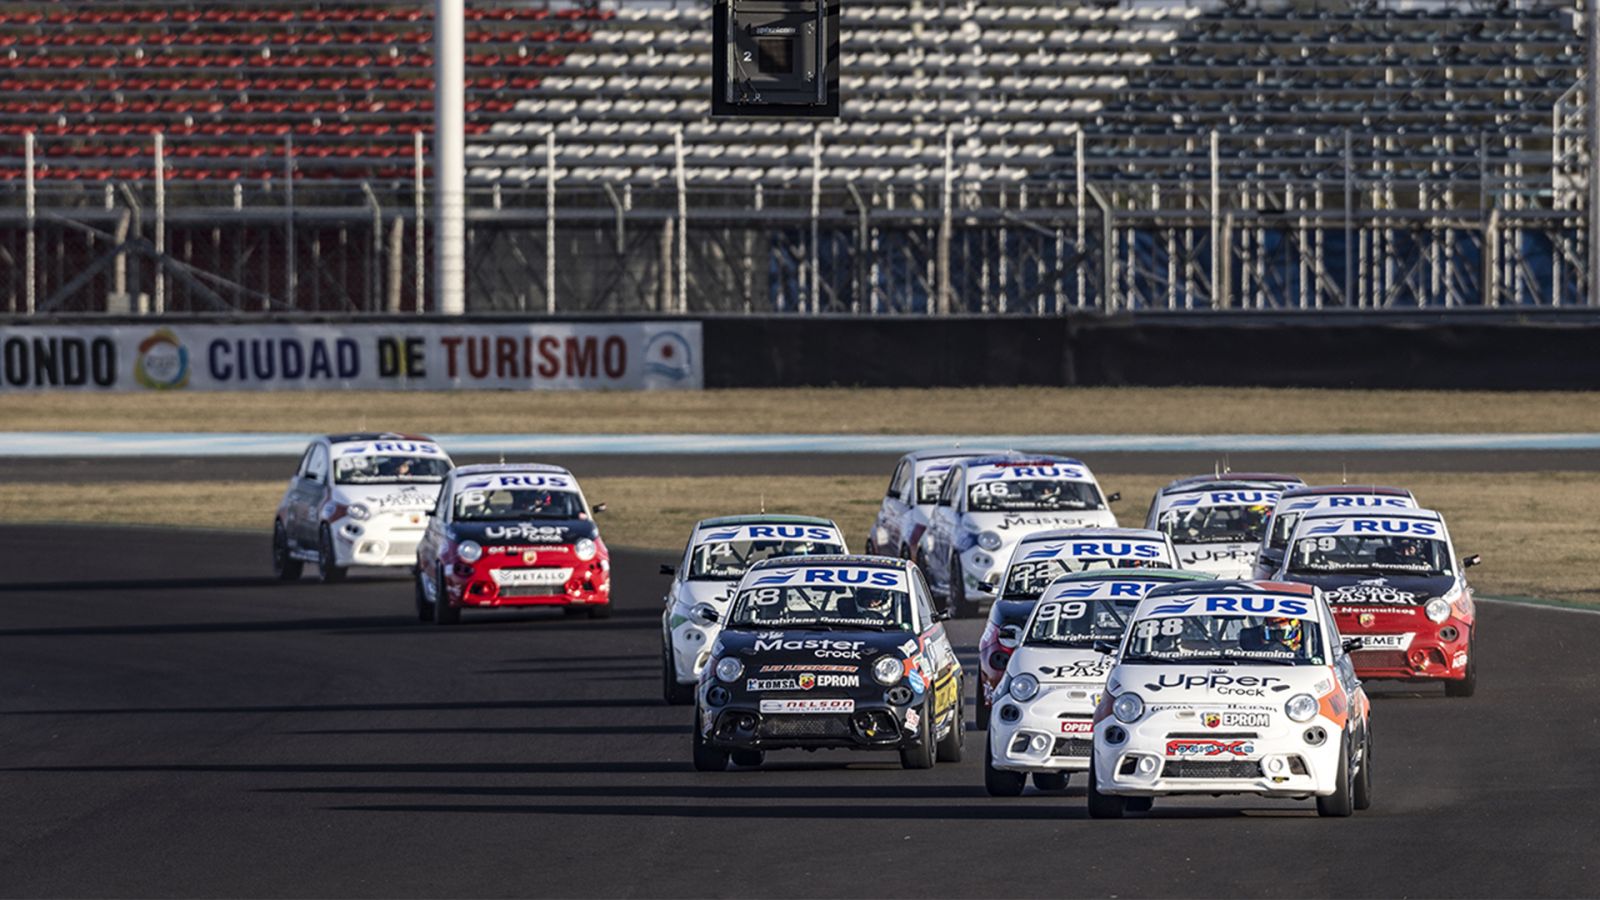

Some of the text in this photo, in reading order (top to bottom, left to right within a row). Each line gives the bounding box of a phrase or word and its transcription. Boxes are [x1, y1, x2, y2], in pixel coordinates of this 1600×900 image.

[743, 51, 752, 62] 2
[0, 336, 117, 387] ONDO
[208, 337, 361, 381] CIUDAD
[377, 336, 427, 379] DE
[440, 335, 627, 379] TURISMO
[374, 442, 438, 454] RUS
[1014, 467, 1083, 478] RUS
[499, 476, 568, 487] RUS
[970, 482, 1009, 498] 46
[1003, 517, 1086, 526] Master
[1160, 509, 1198, 527] 47
[485, 525, 569, 539] Upper
[749, 526, 831, 540] RUS
[1353, 520, 1437, 536] RUS
[695, 542, 733, 558] 14
[1072, 543, 1160, 558] RUS
[1300, 537, 1336, 553] 69
[1190, 549, 1256, 561] Upp
[513, 573, 565, 581] METALLO
[805, 569, 898, 586] RUS
[1014, 562, 1049, 581] 22
[741, 587, 780, 607] 18
[1325, 591, 1418, 605] PASTOR
[1037, 602, 1087, 621] 99
[1206, 597, 1308, 615] RUS
[1138, 618, 1184, 639] 88
[754, 639, 866, 652] Master
[814, 649, 862, 660] Crock
[1053, 665, 1105, 678] PAS
[758, 675, 860, 689] KOMSA EPROM
[1158, 674, 1281, 690] Upper
[1217, 687, 1265, 698] Crock
[1222, 712, 1270, 727] EPROM
